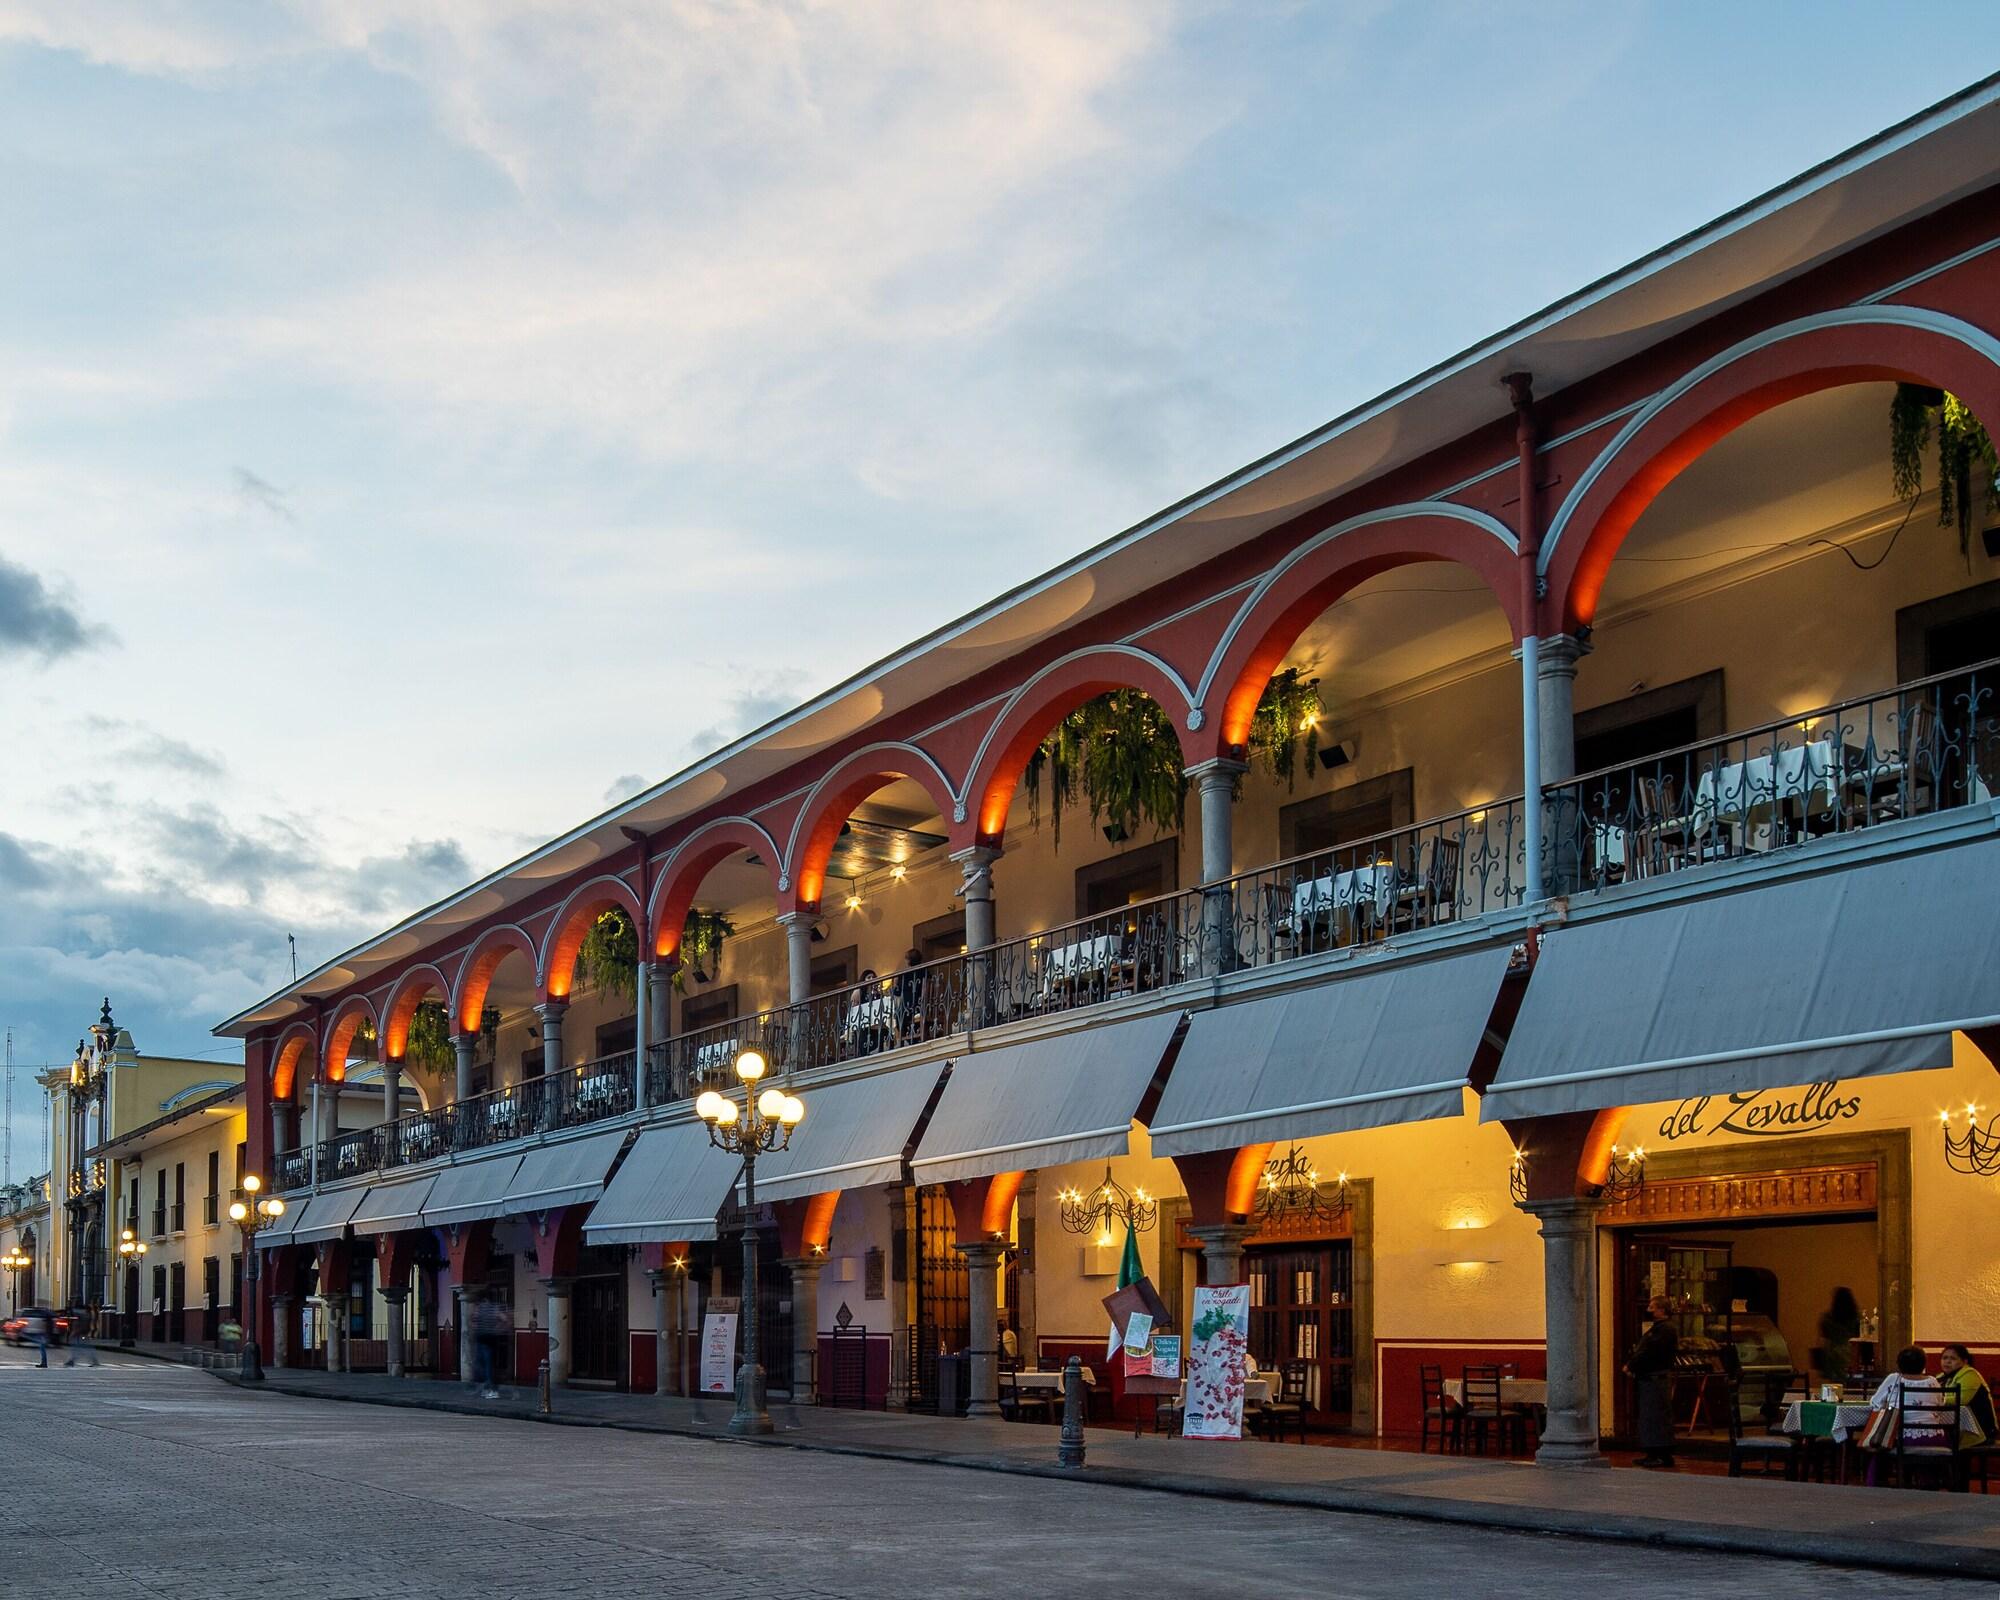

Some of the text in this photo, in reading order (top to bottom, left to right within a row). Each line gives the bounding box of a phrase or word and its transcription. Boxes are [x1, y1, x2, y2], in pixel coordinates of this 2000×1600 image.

[1659, 1081, 1862, 1140] del Zevallos
[1212, 1290, 1232, 1298] Chile
[1212, 1296, 1241, 1306] nogada
